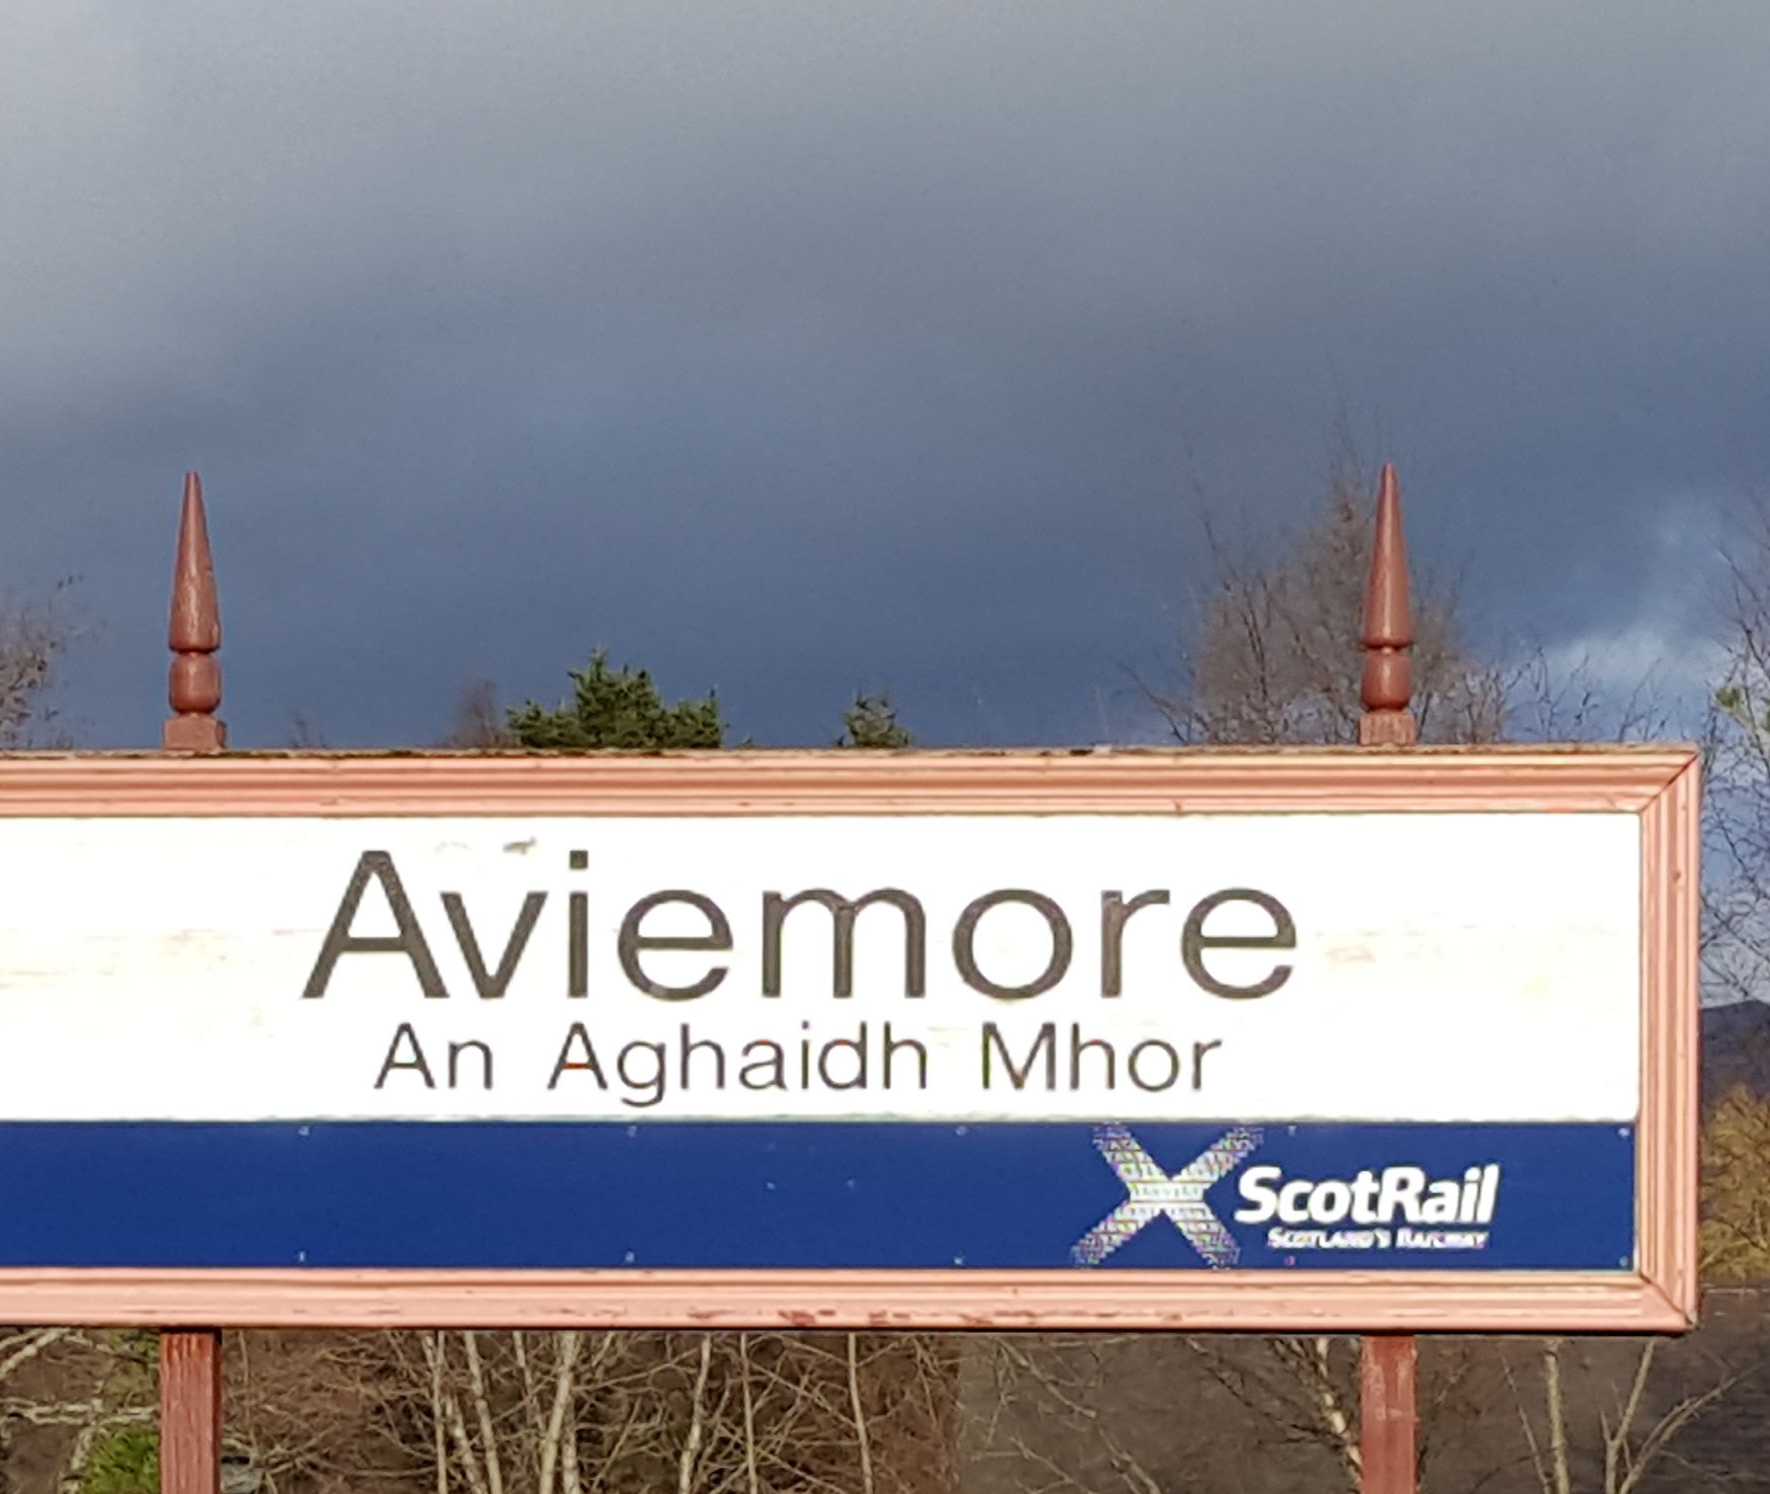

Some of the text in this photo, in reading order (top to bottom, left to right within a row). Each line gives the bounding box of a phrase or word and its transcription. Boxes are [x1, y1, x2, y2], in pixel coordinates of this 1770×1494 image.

[303, 850, 1296, 1001] Aviemore
[375, 1022, 1222, 1108] An Aghaidh Mhor
[1235, 1164, 1499, 1225] ScotRail
